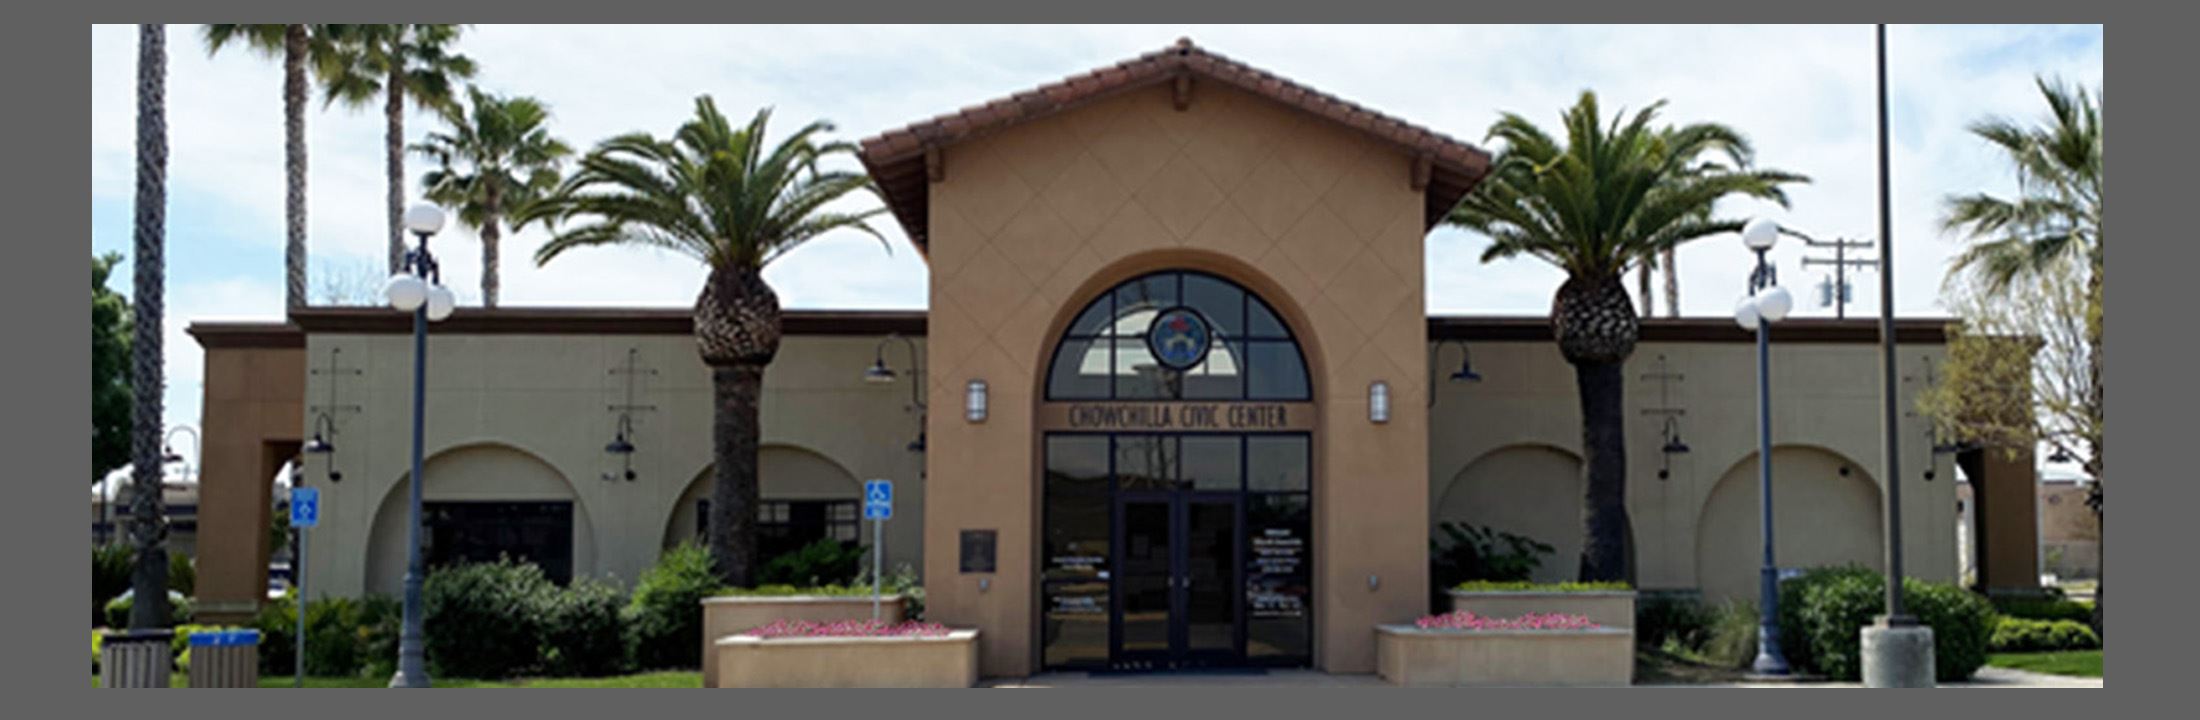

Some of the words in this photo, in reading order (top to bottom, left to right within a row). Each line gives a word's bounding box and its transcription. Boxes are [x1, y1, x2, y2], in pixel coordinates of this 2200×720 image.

[1068, 405, 1171, 428] CHOWCHILLA
[1179, 405, 1219, 427] CIVIC
[1227, 405, 1287, 427] CENTER
